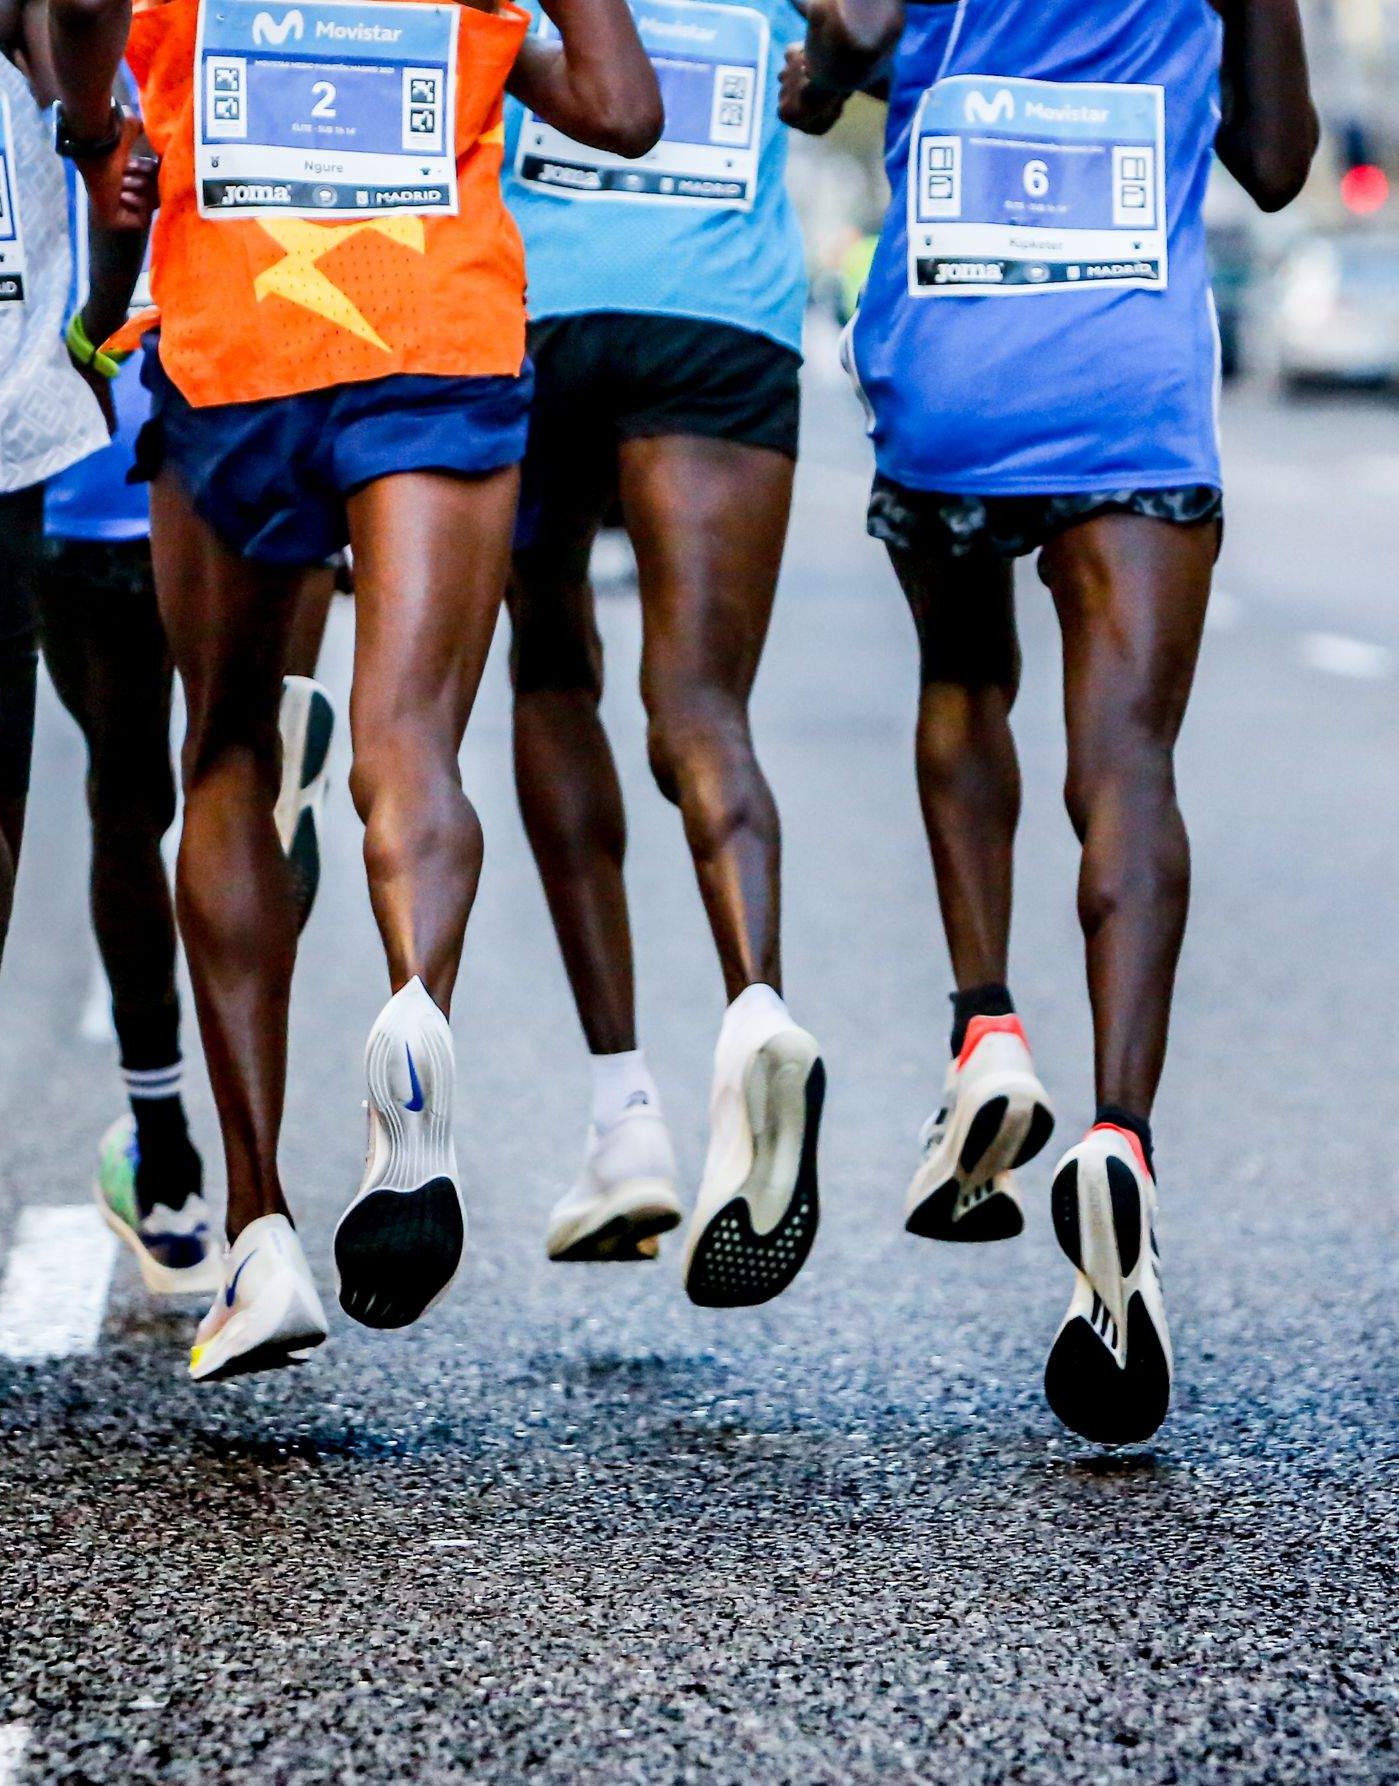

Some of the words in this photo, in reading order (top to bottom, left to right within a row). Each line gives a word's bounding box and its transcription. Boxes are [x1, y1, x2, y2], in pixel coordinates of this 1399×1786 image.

[315, 20, 402, 43] Movistar
[311, 81, 337, 118] 2
[1025, 101, 1110, 123] Movistar
[304, 160, 343, 174] Ngure
[1024, 160, 1050, 197] 6
[376, 189, 442, 203] MADRID
[1087, 264, 1152, 279] MADRID
